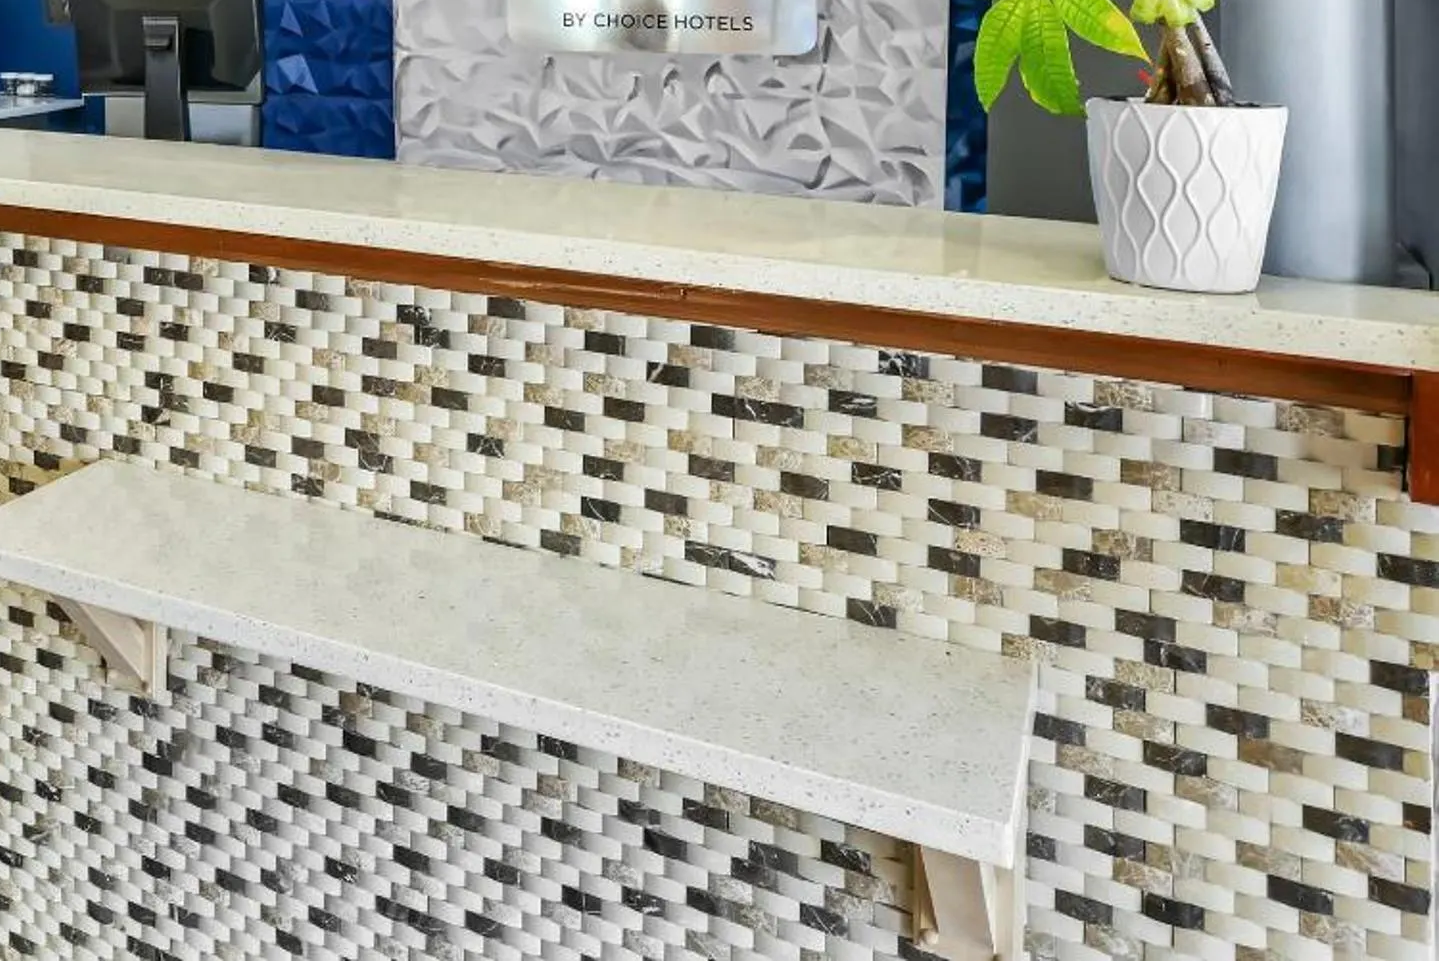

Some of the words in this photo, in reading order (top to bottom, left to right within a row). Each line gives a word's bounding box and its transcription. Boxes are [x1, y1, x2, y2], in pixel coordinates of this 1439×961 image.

[562, 12, 587, 28] BY
[593, 13, 669, 30] CHOICE
[674, 14, 754, 32] HOTELS
